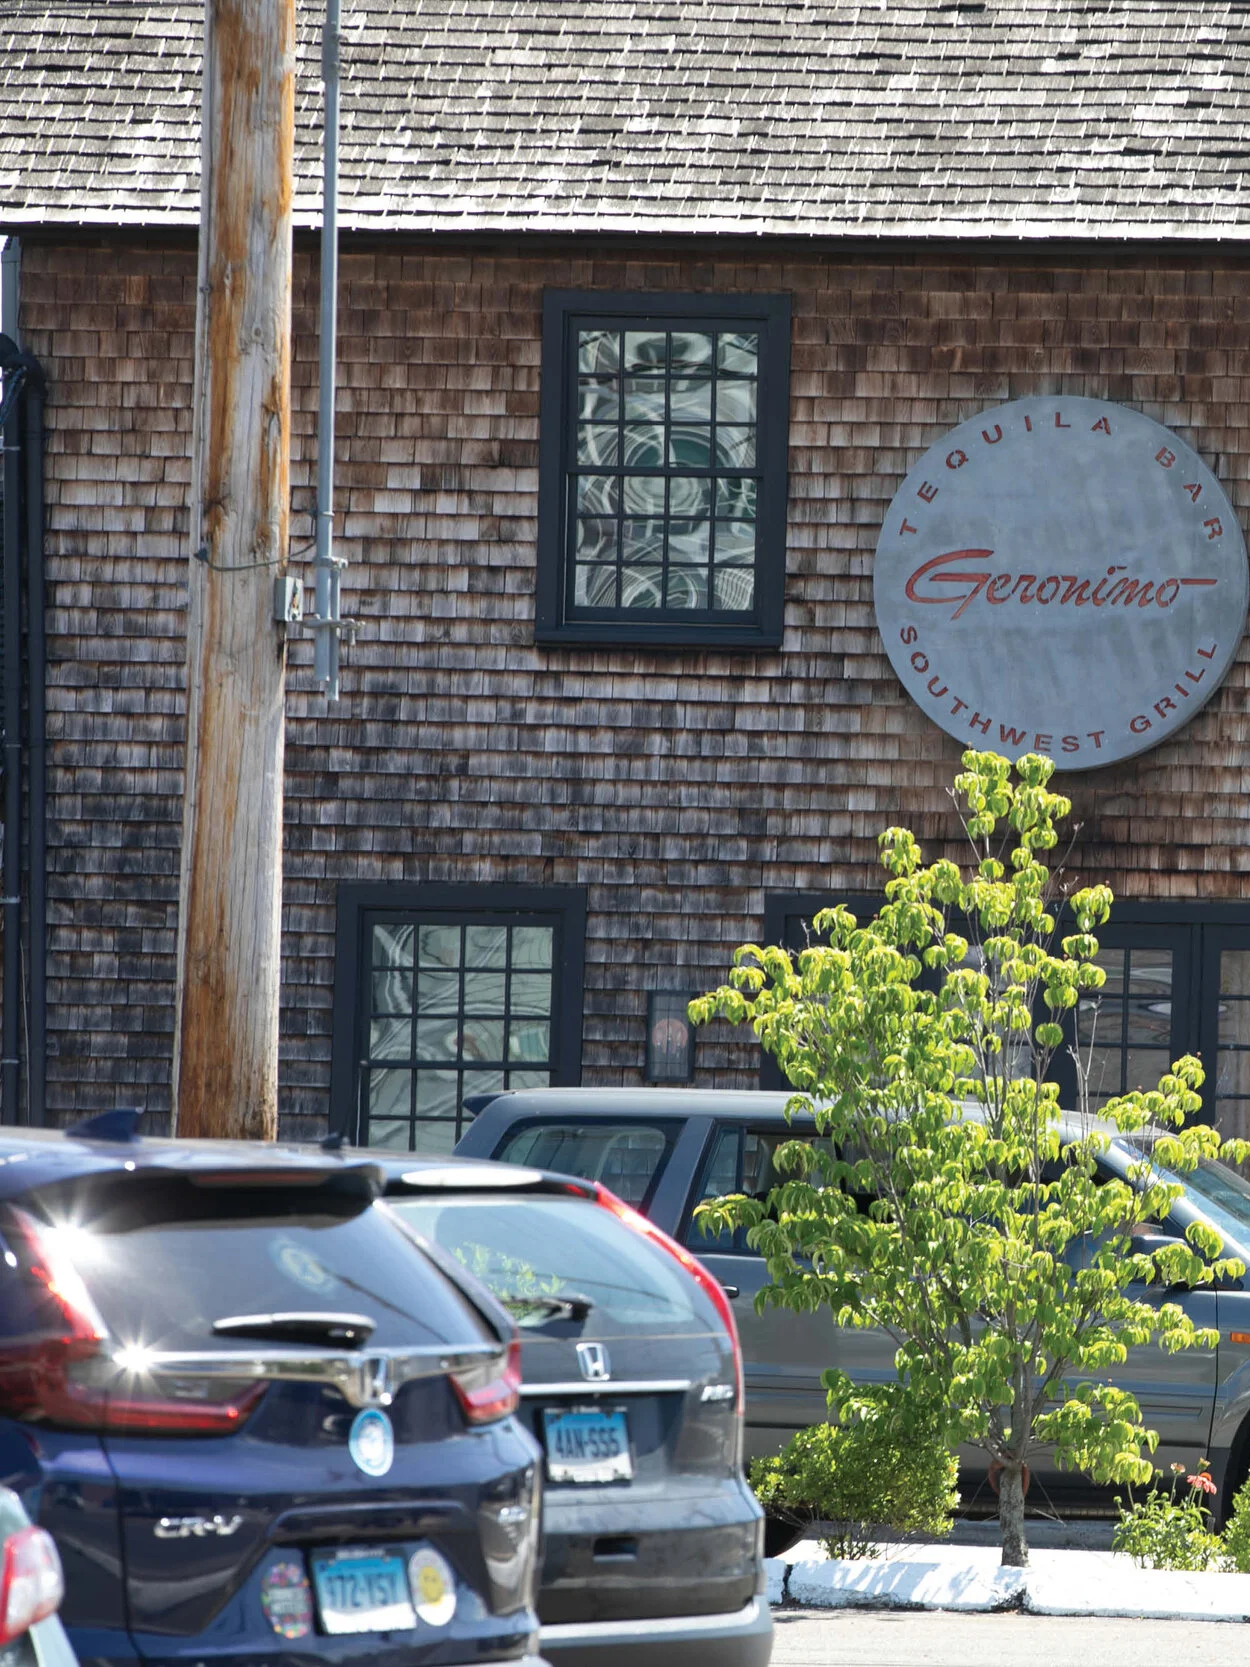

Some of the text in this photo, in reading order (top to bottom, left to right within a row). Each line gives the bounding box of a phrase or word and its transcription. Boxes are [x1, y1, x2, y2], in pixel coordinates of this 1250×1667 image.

[900, 411, 1224, 541] TEQUILA BAR
[905, 548, 1218, 621] Geronimo
[900, 624, 1218, 753] SOUTHWEST GRILL
